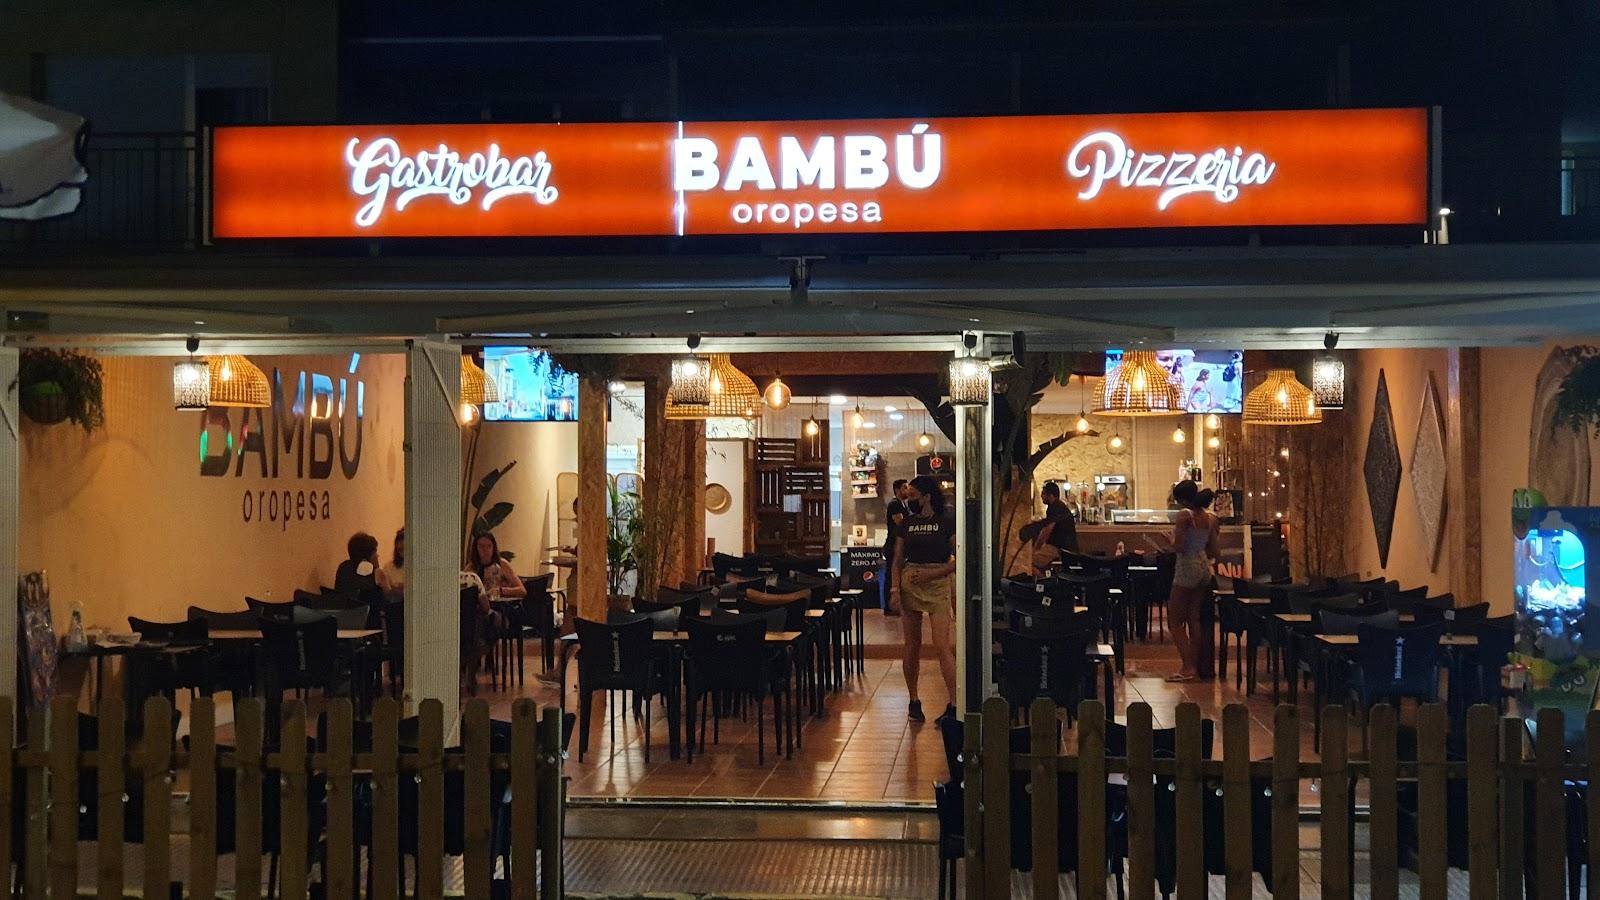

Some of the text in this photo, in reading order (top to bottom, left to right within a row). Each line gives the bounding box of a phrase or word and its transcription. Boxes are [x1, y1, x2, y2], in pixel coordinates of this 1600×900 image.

[346, 137, 559, 227] Gastrobar
[674, 123, 942, 191] BAMBÚ
[1067, 131, 1276, 211] Pizzeria
[732, 201, 882, 229] oropesa
[200, 352, 366, 480] BAMBÚ
[242, 489, 331, 532] oropesa
[908, 522, 939, 532] BAMBÚ
[1394, 646, 1402, 679] Heineken
